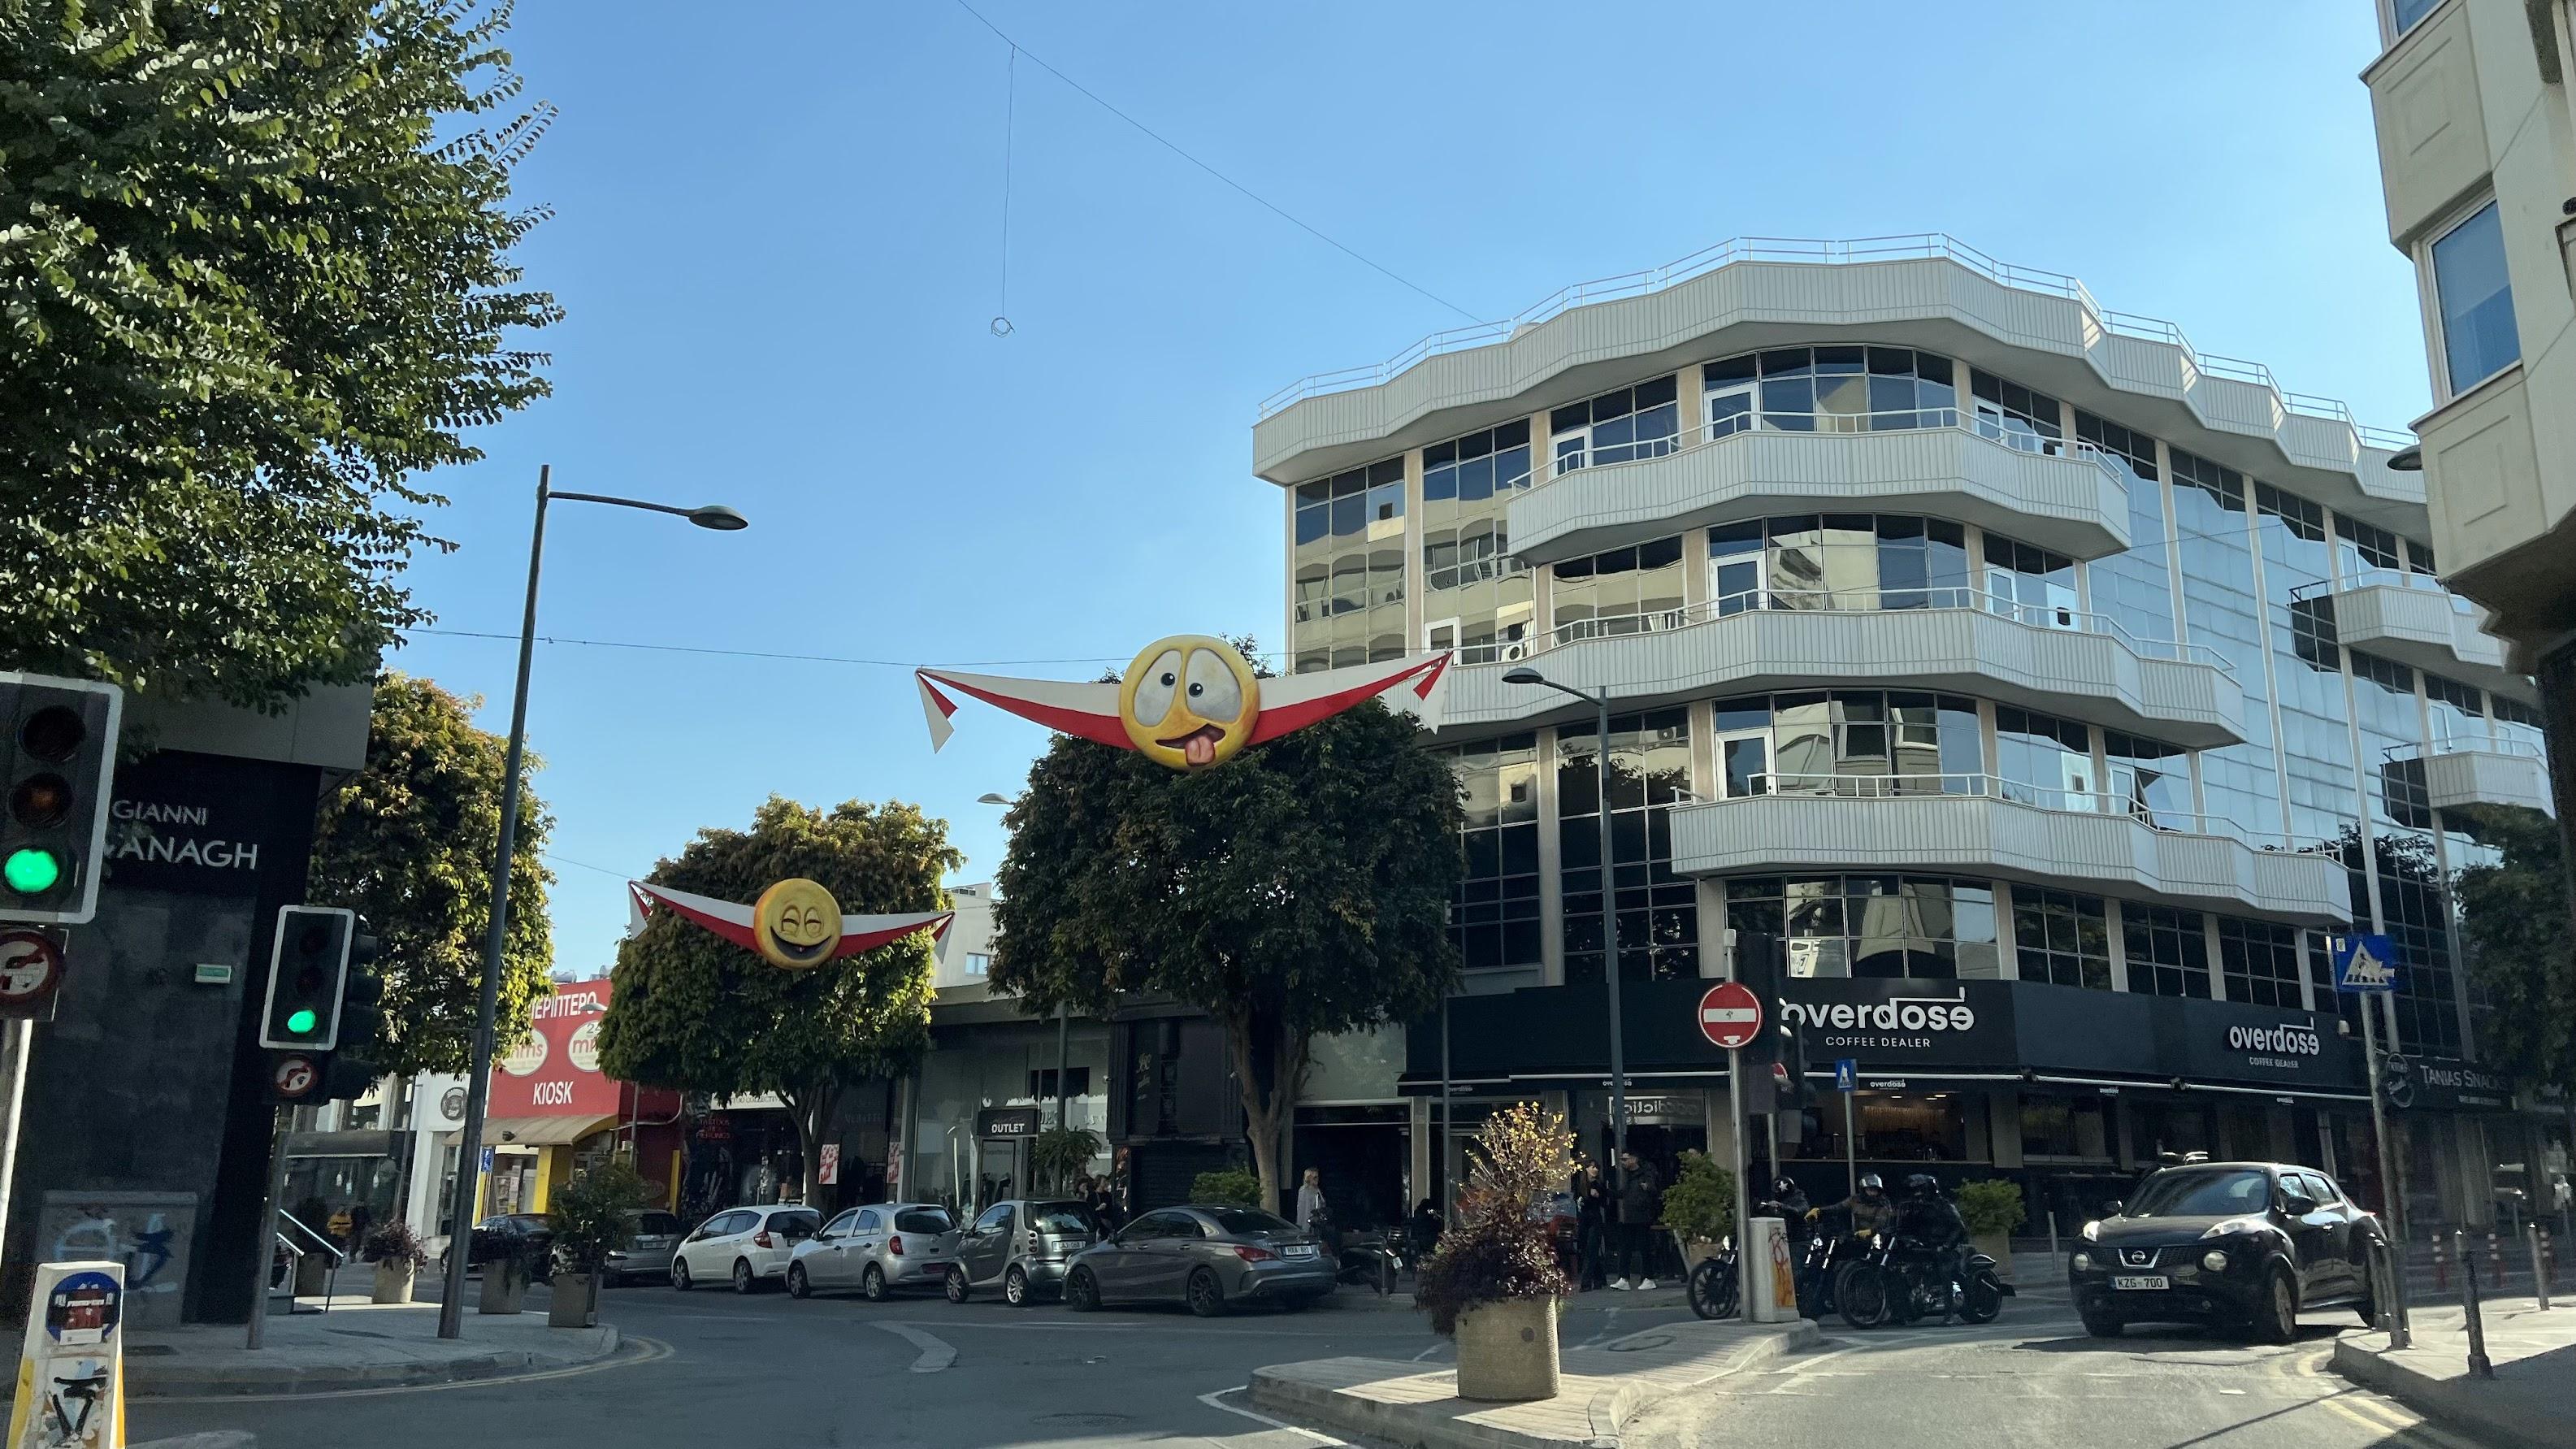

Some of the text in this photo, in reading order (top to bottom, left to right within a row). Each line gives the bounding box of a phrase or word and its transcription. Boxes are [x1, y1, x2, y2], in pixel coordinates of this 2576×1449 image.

[111, 799, 208, 826] GIANNI
[1780, 987, 1975, 1031] overdose
[1825, 1036, 1932, 1048] COFFEE DEALER
[2229, 1016, 2320, 1056] overdose
[2419, 1064, 2462, 1087] TANIAS
[533, 1081, 573, 1105] KIOSK
[991, 1122, 1026, 1134] OUTLET
[2144, 1278, 2163, 1288] 700
